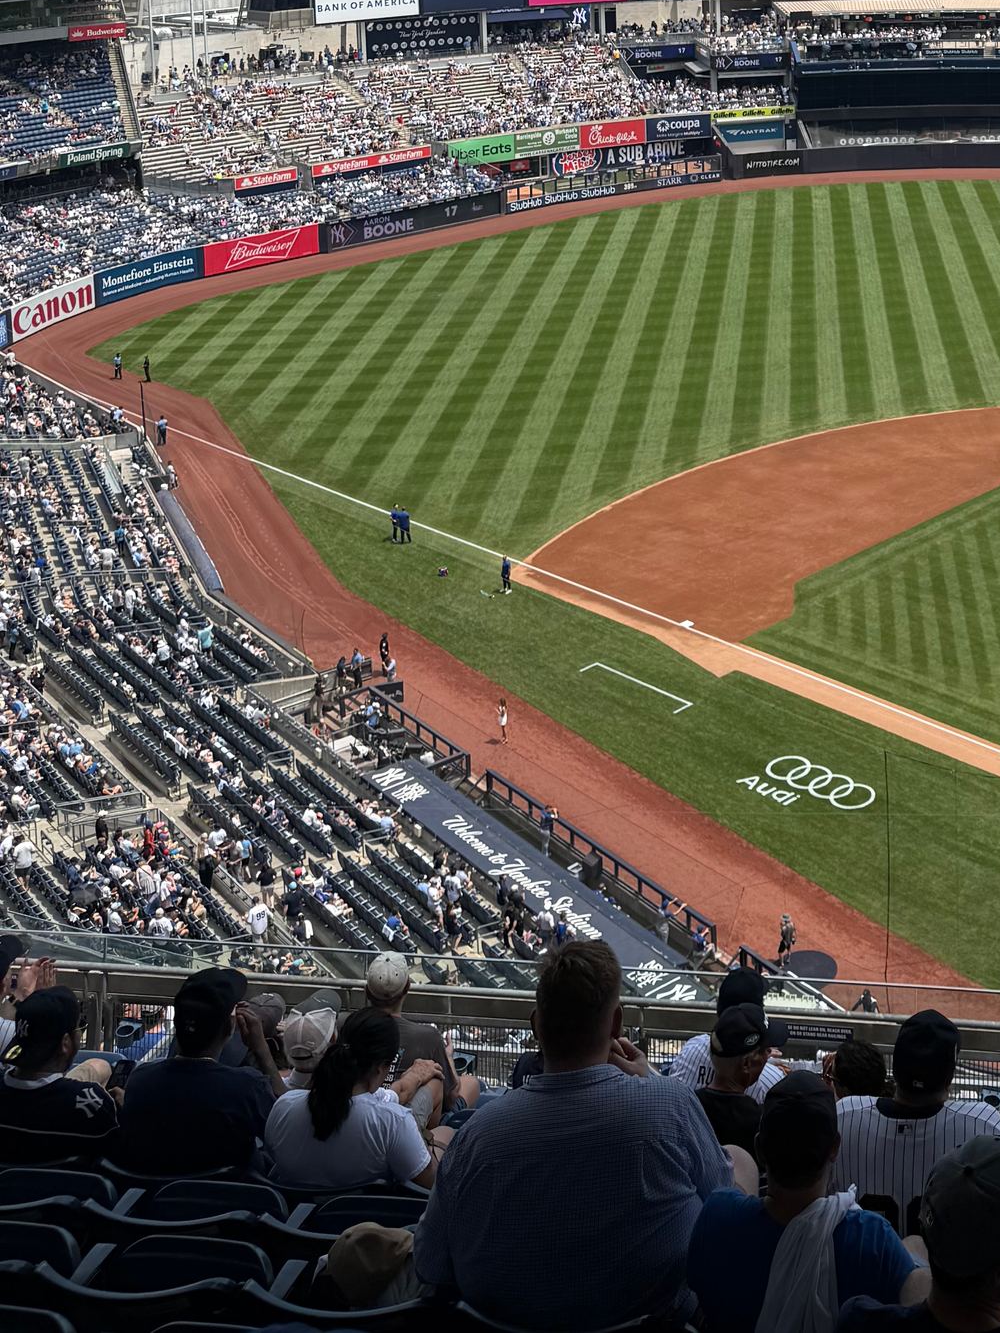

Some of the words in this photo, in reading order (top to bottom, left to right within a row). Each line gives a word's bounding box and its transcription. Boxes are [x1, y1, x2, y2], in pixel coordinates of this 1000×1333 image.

[317, 2, 347, 13] BANK
[350, 0, 365, 10] OF
[87, 27, 125, 37] Budweiser
[635, 51, 662, 59] BOONE
[734, 59, 760, 67] BOONE
[713, 111, 737, 119] Gillette
[742, 109, 765, 117] Gillette
[771, 107, 794, 115] Gillette
[670, 119, 700, 133] coupa
[740, 127, 777, 135] AMTRAK
[589, 129, 638, 146] Chick-fil-A
[67, 152, 95, 165] Poland
[96, 147, 123, 160] Spring
[451, 146, 480, 161] Uber
[482, 142, 512, 156] Eats
[607, 149, 616, 165] A
[619, 145, 644, 163] SUB
[657, 177, 682, 187] STARR
[510, 198, 542, 212] StubHub
[545, 191, 578, 204] StubHub
[581, 187, 615, 199] StubHub
[444, 205, 458, 217] 17
[363, 216, 390, 226] AARON
[363, 218, 414, 240] BOONE
[231, 241, 292, 261] Budweiser
[102, 268, 152, 290] Montefiore
[153, 257, 194, 273] Einstein
[13, 284, 93, 335] Canon
[735, 775, 800, 806] Audi
[442, 814, 494, 857] Welcome
[488, 852, 507, 865] to
[488, 858, 552, 899] Yankee
[549, 896, 602, 940] Stadium
